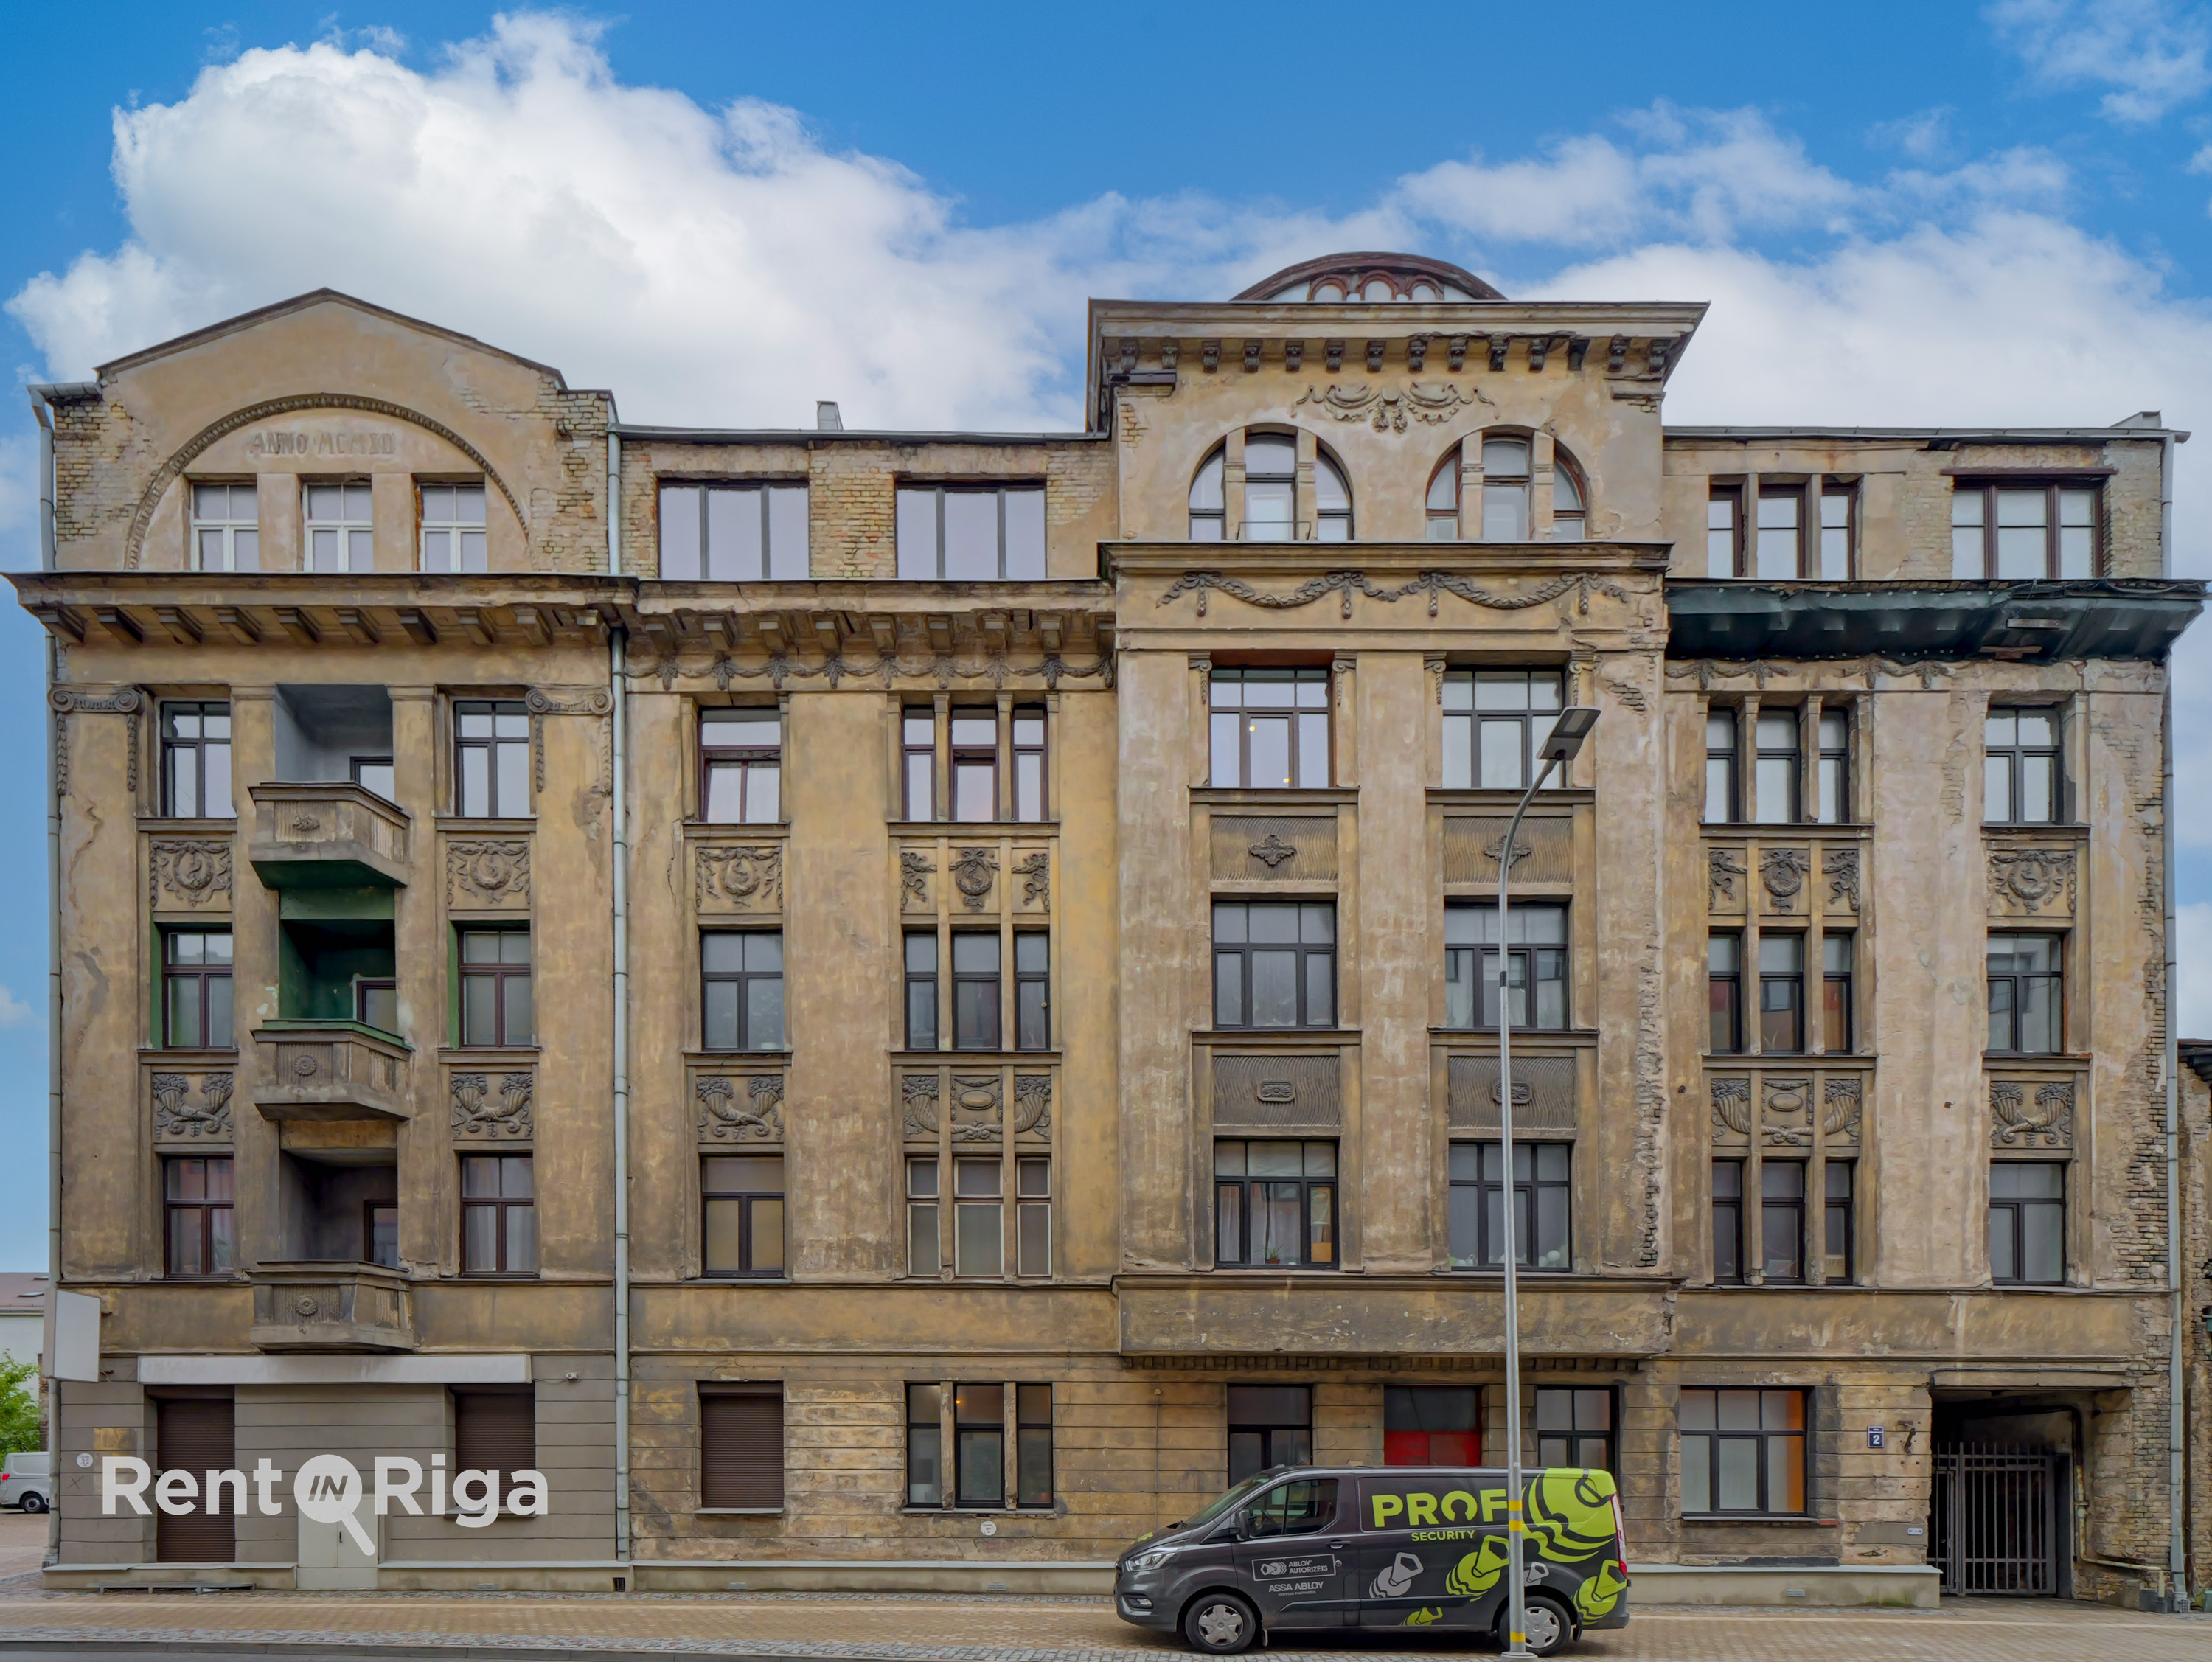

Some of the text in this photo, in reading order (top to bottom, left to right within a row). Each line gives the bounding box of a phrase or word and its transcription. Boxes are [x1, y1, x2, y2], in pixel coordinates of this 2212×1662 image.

[249, 431, 309, 455] ANNO
[1873, 1434, 1880, 1444] 2
[1371, 1489, 1508, 1528] PROF
[1411, 1530, 1475, 1542] SECURITY
[1289, 1565, 1328, 1574] AUTORIZĒTS
[1268, 1581, 1324, 1593] ASSA ABLOY
